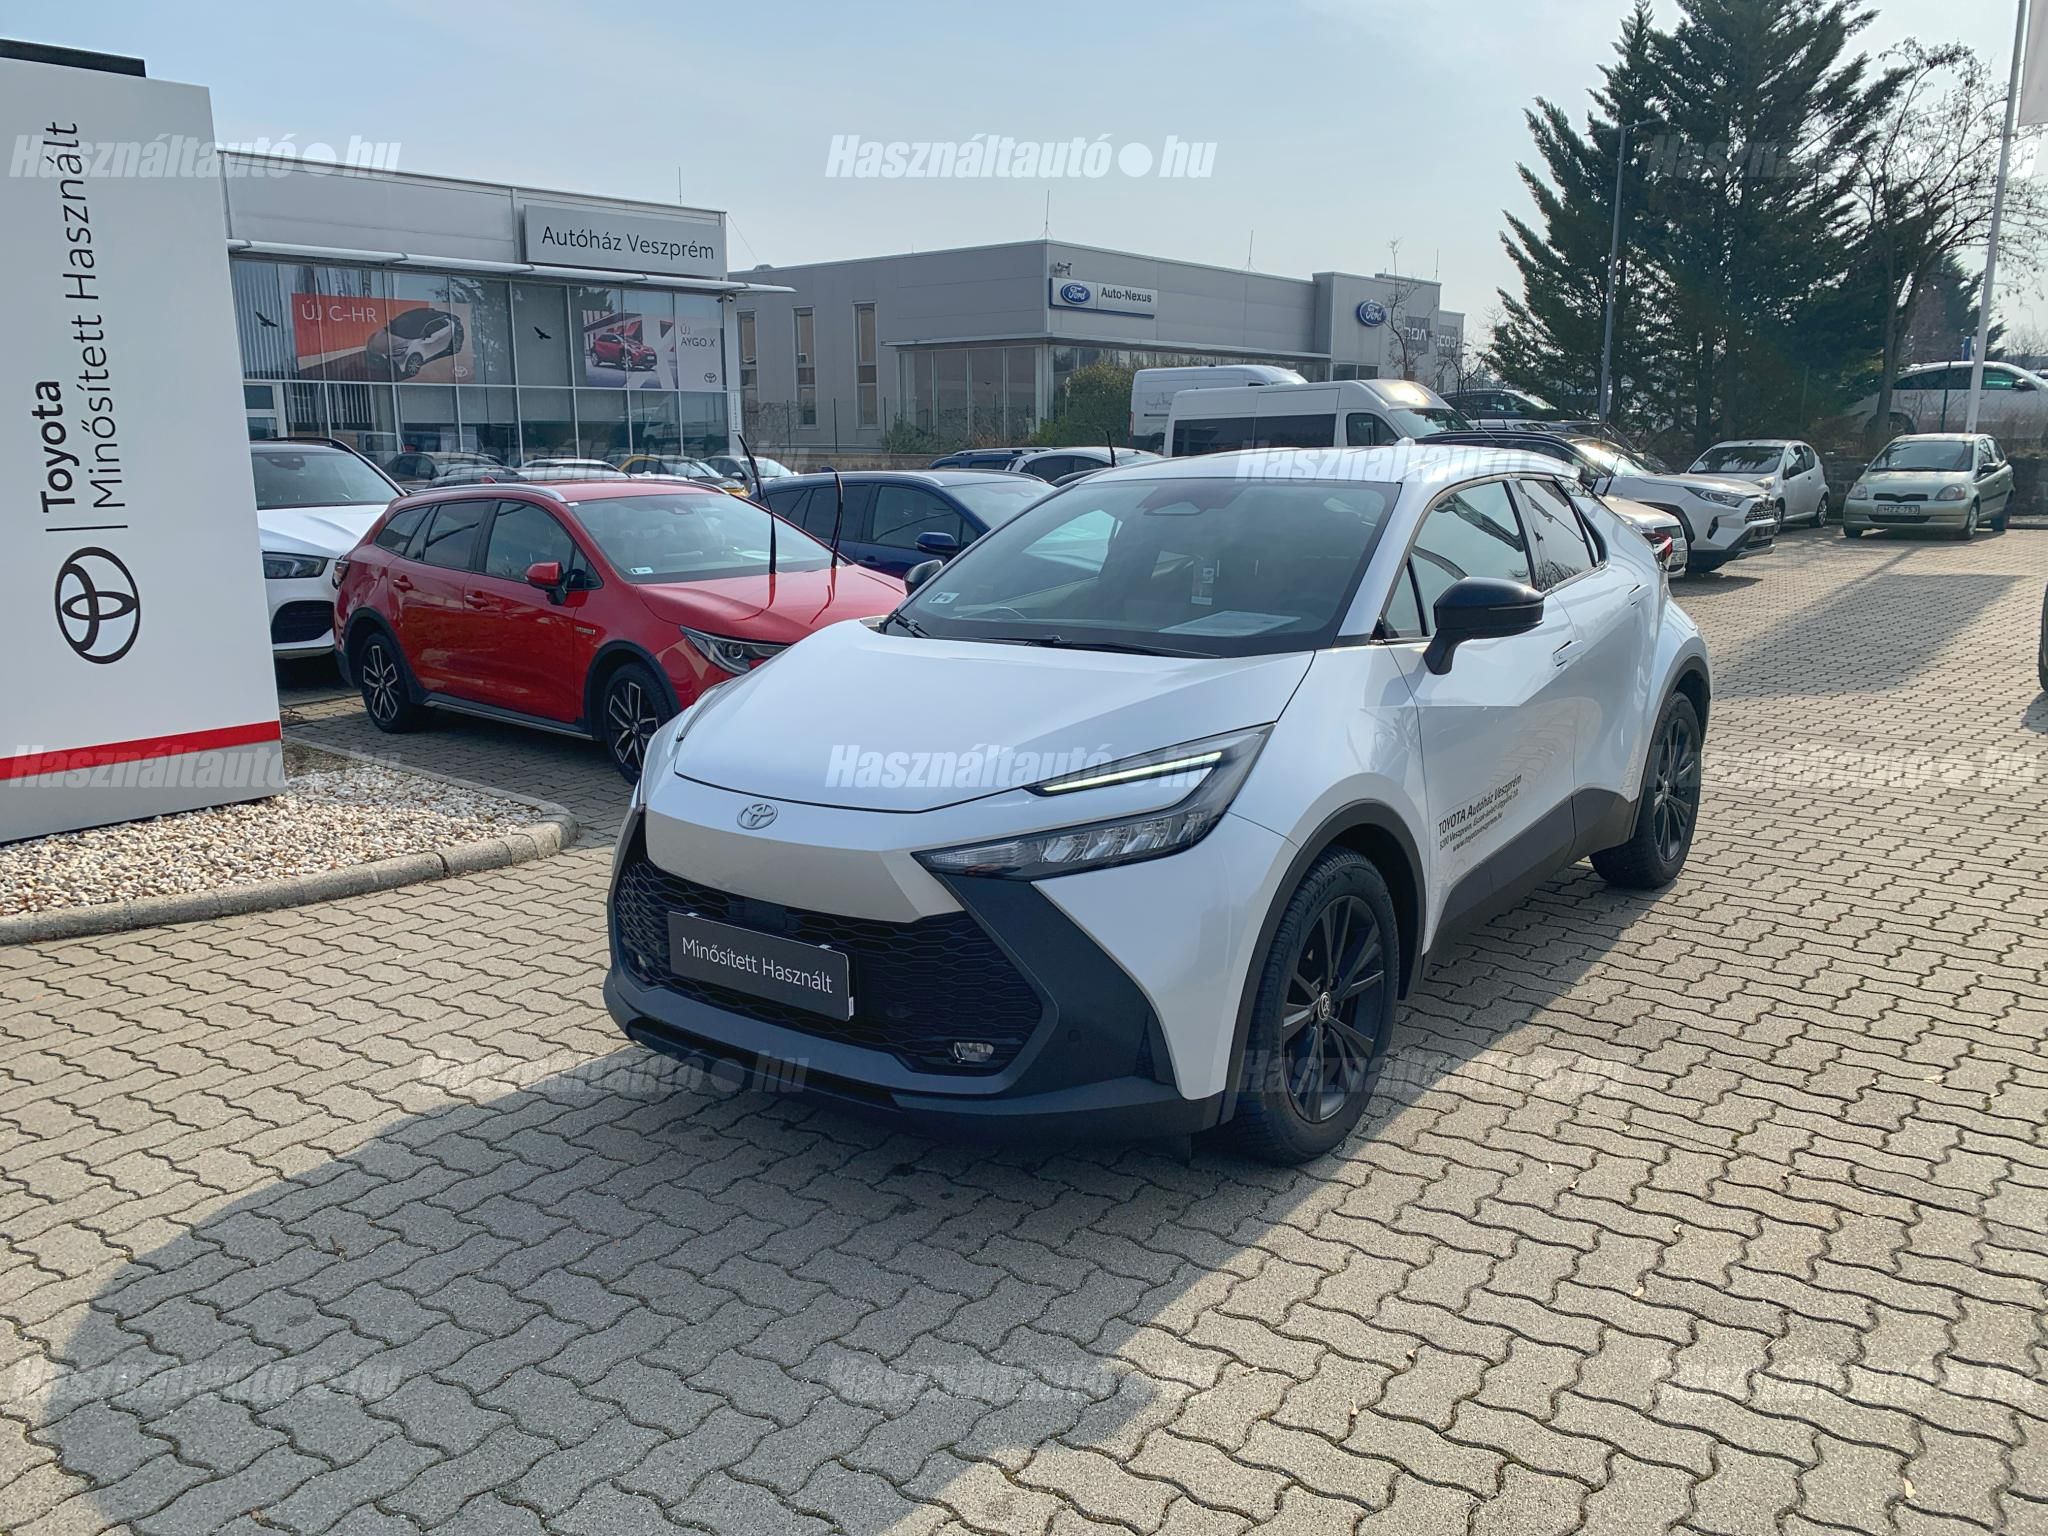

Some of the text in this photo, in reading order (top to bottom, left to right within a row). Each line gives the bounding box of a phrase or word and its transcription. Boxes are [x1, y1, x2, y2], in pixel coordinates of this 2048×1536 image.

[541, 225, 714, 261] Autóház Veszprém
[43, 121, 126, 508] Minősített Használt
[302, 300, 377, 323] ÚJ C-HR
[1101, 287, 1152, 303] Auto-Nexus
[680, 337, 706, 348] AYGO
[32, 380, 80, 513] Toyota
[1439, 773, 1522, 836] TOYOTA Autóház Veszprém
[682, 937, 833, 994] Minősített Használt
